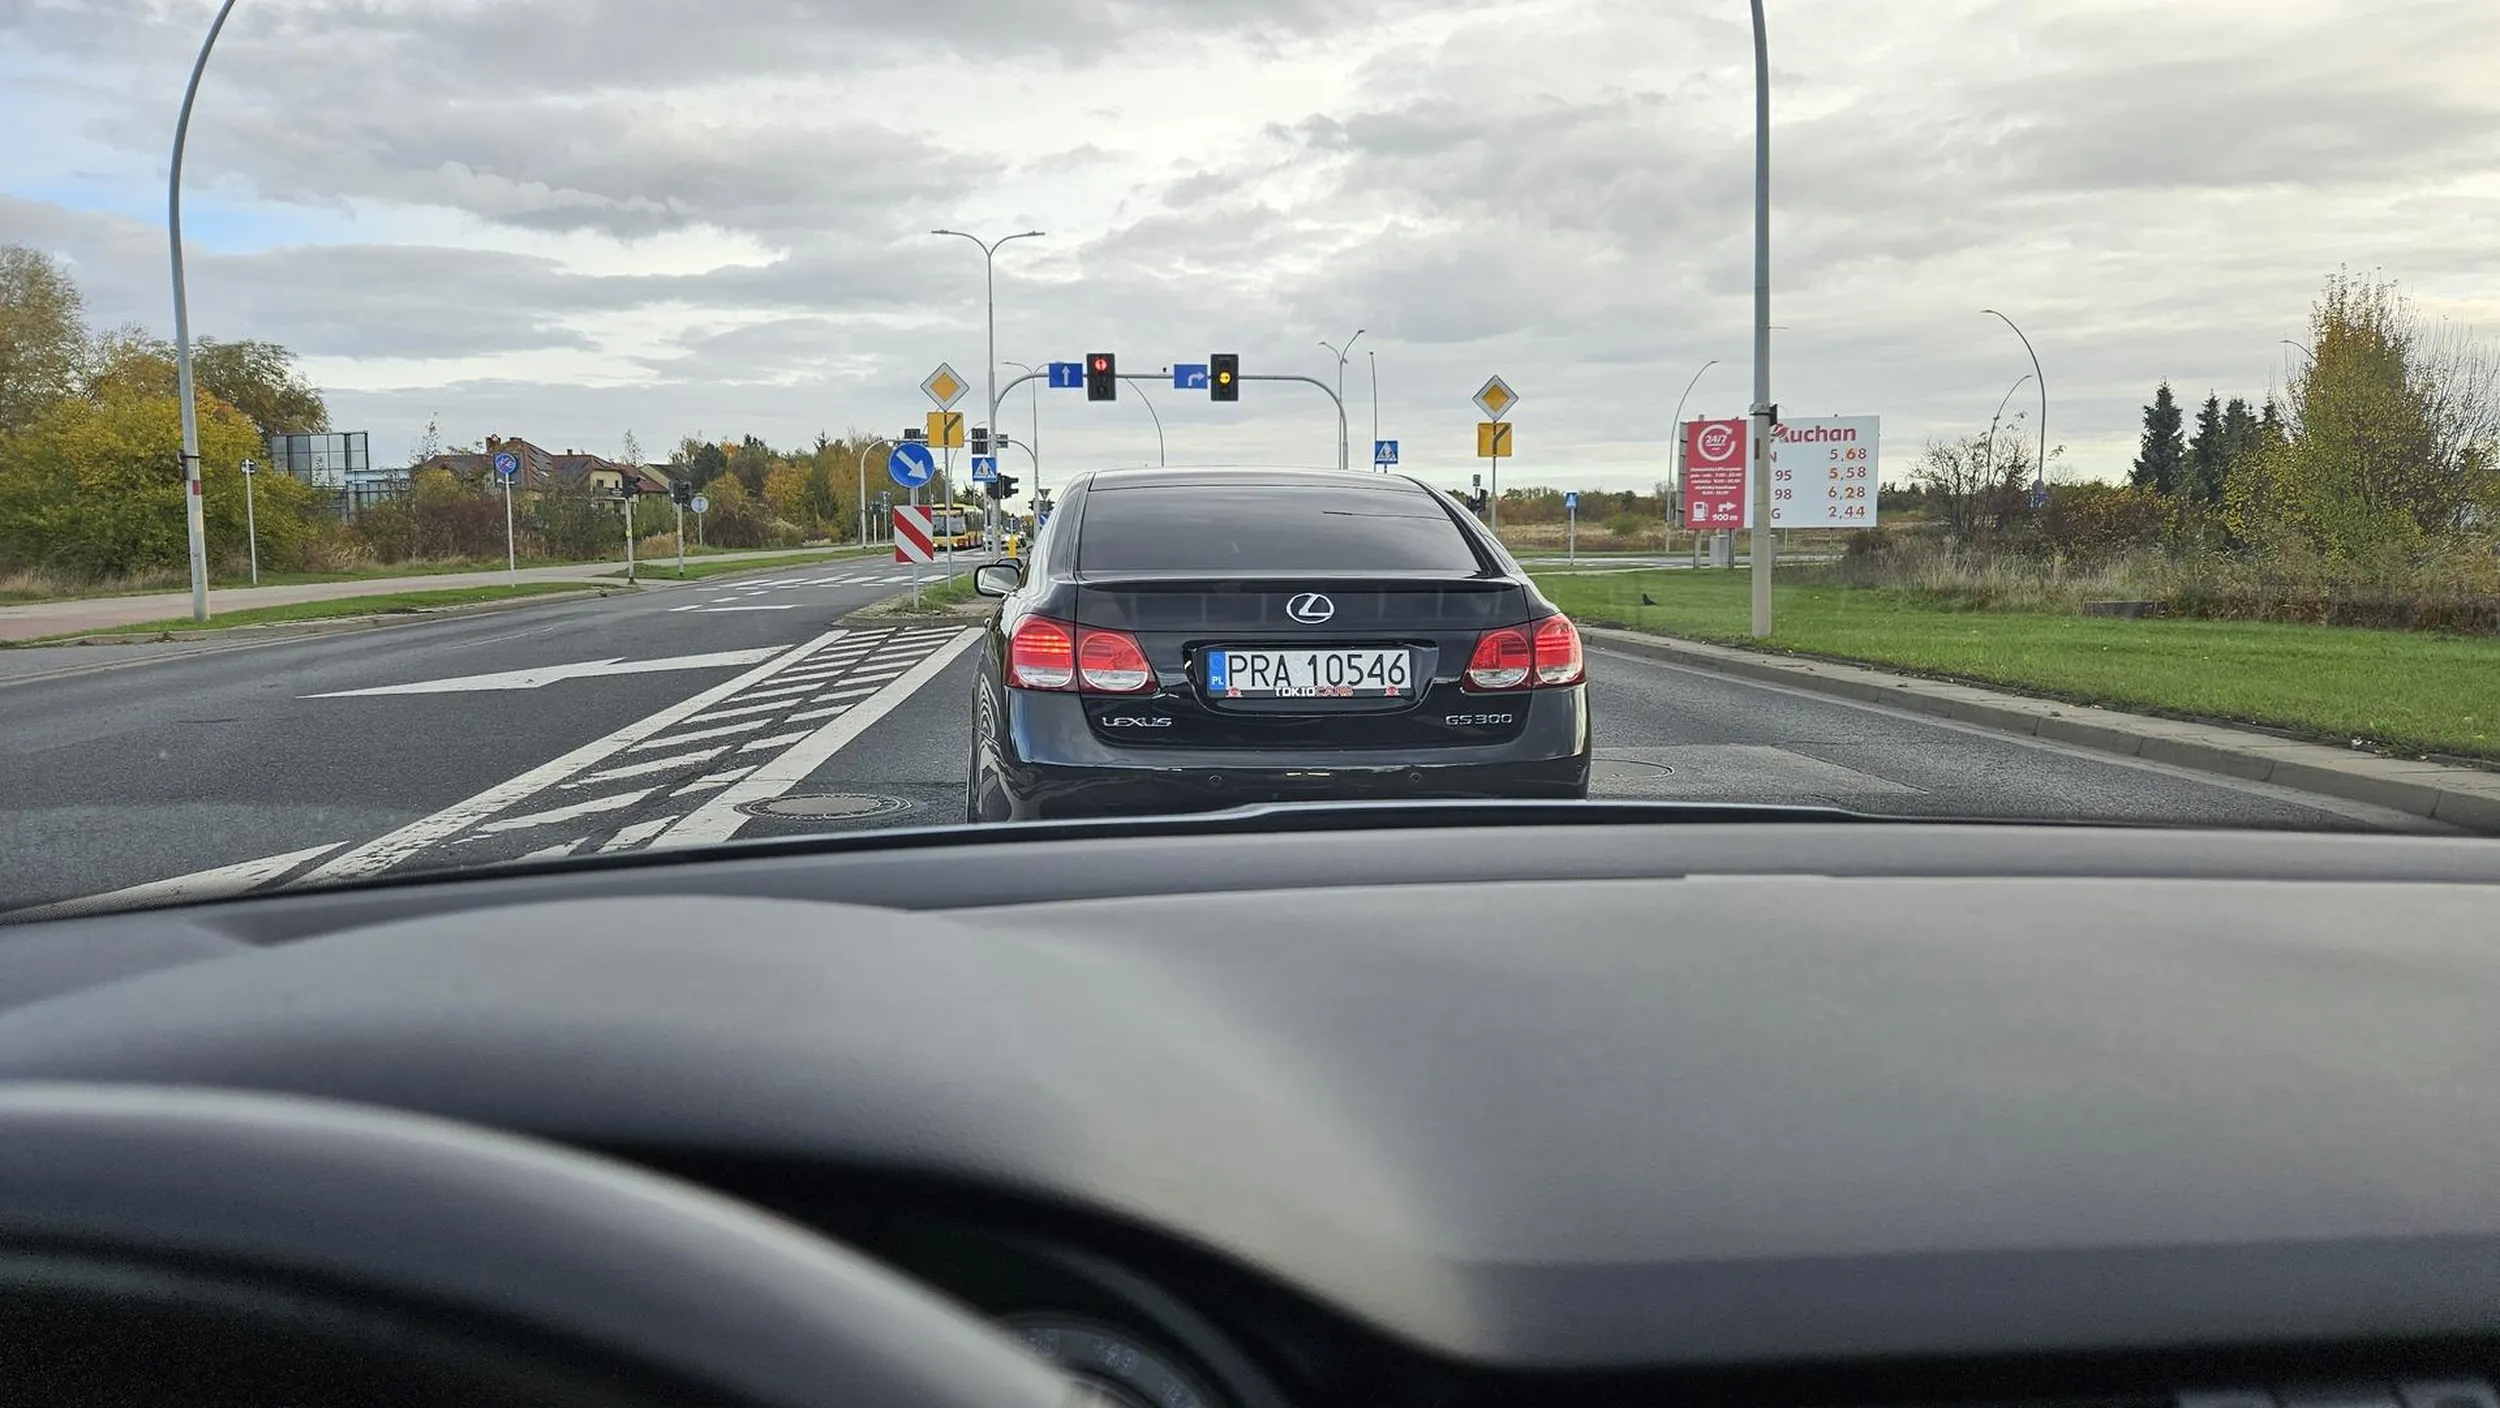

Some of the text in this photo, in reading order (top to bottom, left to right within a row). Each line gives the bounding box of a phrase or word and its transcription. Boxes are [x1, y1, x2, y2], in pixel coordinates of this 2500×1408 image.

[1705, 434, 1727, 447] 24/7
[1829, 447, 1867, 461] 5,68
[1775, 470, 1792, 480] 95
[1829, 466, 1866, 480] 5,58
[1775, 489, 1792, 500] 98
[1828, 486, 1865, 500] 6,28
[1828, 506, 1865, 519] 2,44
[1229, 653, 1405, 687] PRA 10546
[1212, 676, 1224, 686] PL
[1102, 717, 1172, 727] LEXUS
[1445, 714, 1512, 725] GS 300
